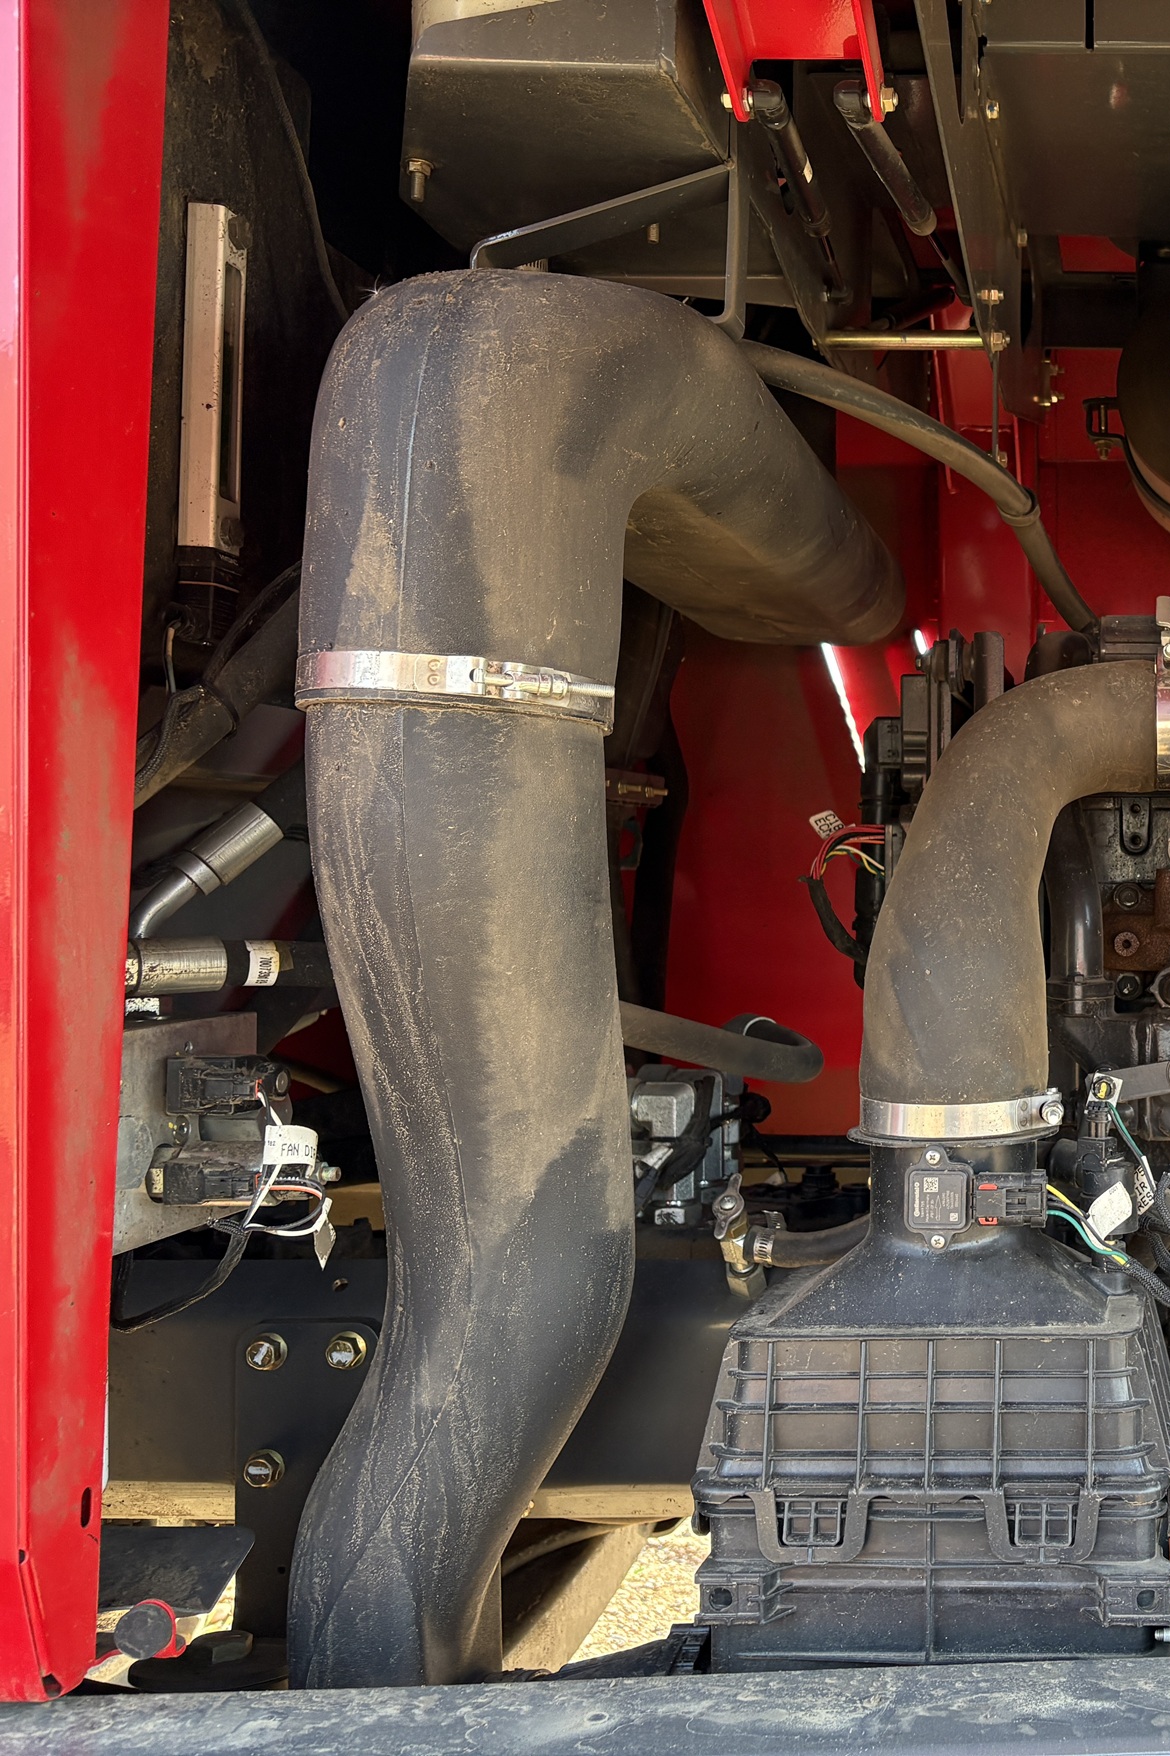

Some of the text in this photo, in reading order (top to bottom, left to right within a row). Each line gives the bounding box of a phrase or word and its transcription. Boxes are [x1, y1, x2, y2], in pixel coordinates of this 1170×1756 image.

[825, 813, 844, 834] C18
[281, 1143, 300, 1156] FAN
[1134, 1166, 1145, 1181] 75
[1136, 1182, 1147, 1196] IR
[1138, 1193, 1153, 1211] RES
